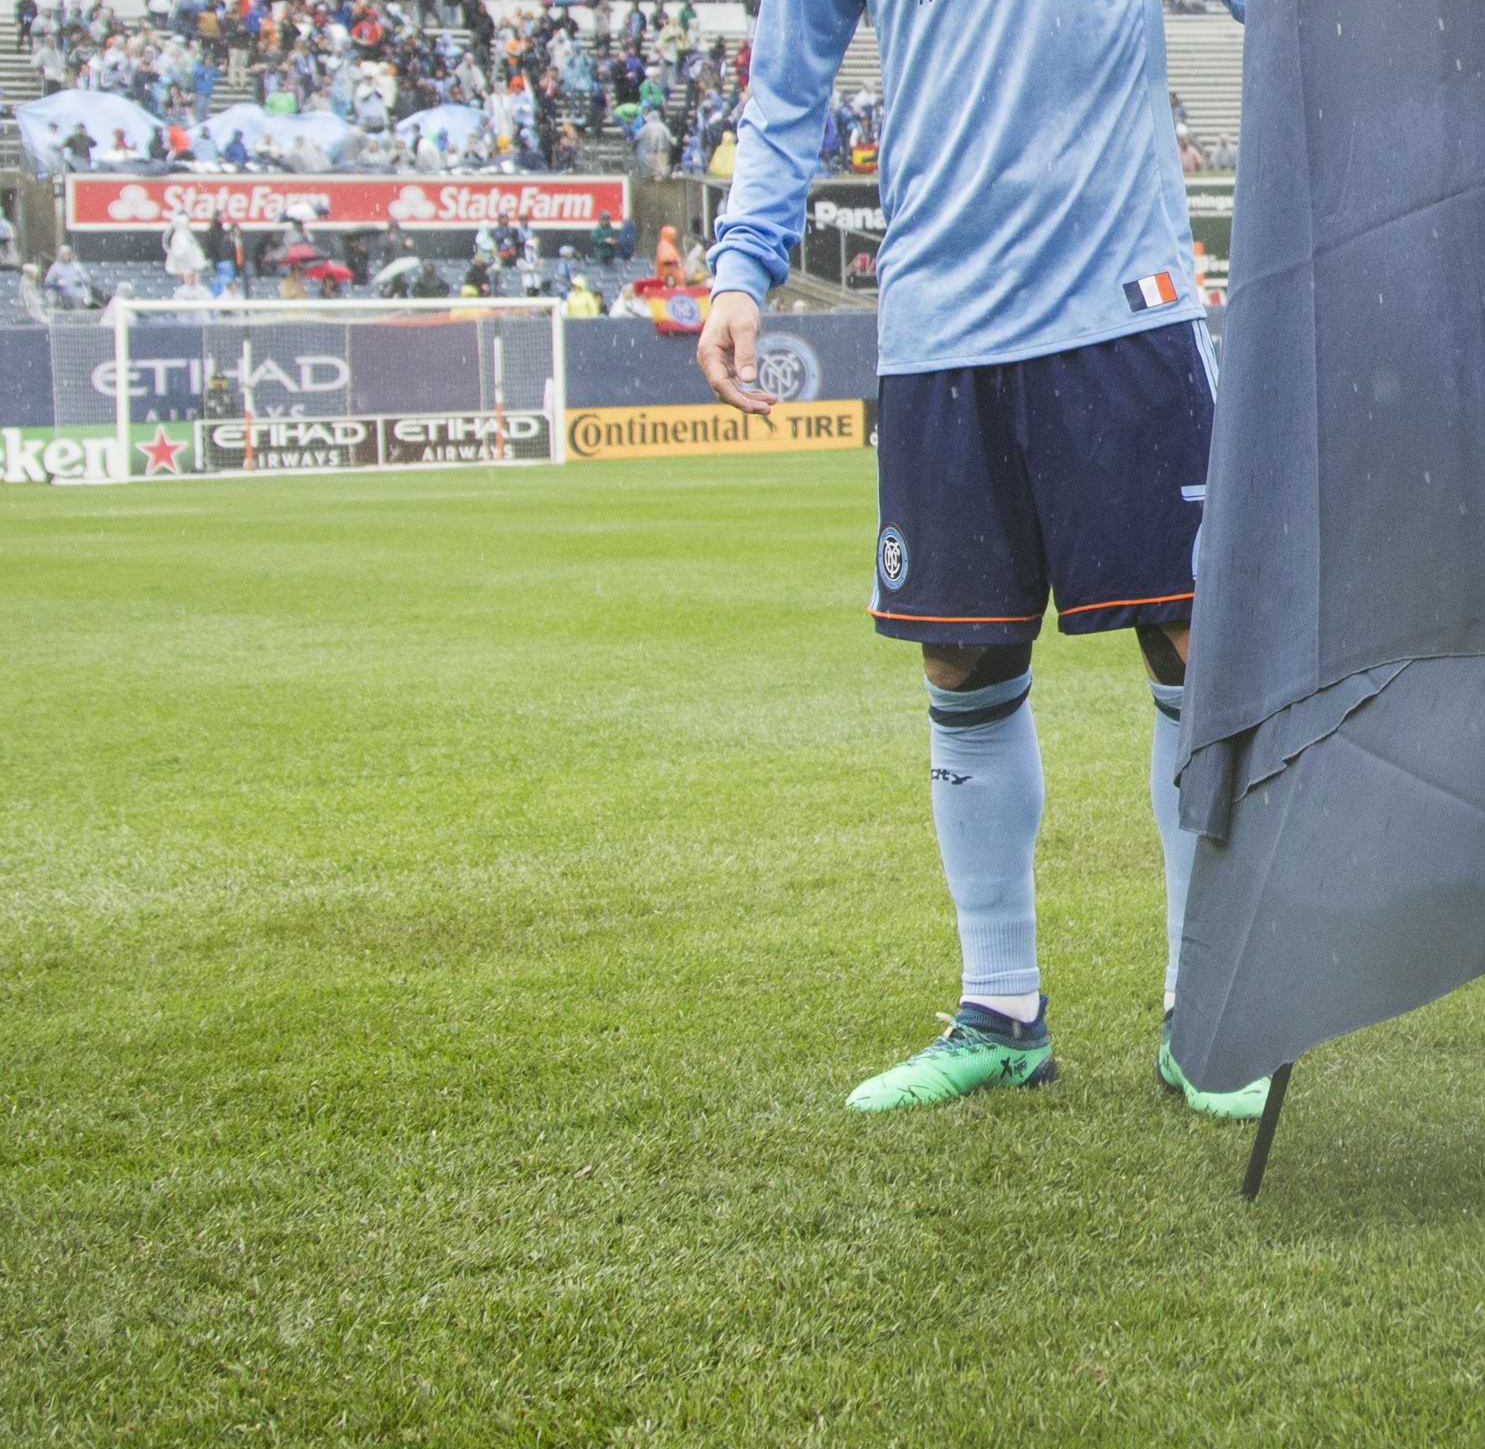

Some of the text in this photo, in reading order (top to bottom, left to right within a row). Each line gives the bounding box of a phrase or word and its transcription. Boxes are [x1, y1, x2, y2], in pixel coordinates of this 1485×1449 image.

[90, 354, 350, 397] ETIHAD
[212, 422, 367, 449] ETIHAD
[394, 416, 540, 442] ETIHAD
[568, 412, 750, 457] Continental
[786, 414, 854, 440] TIRE
